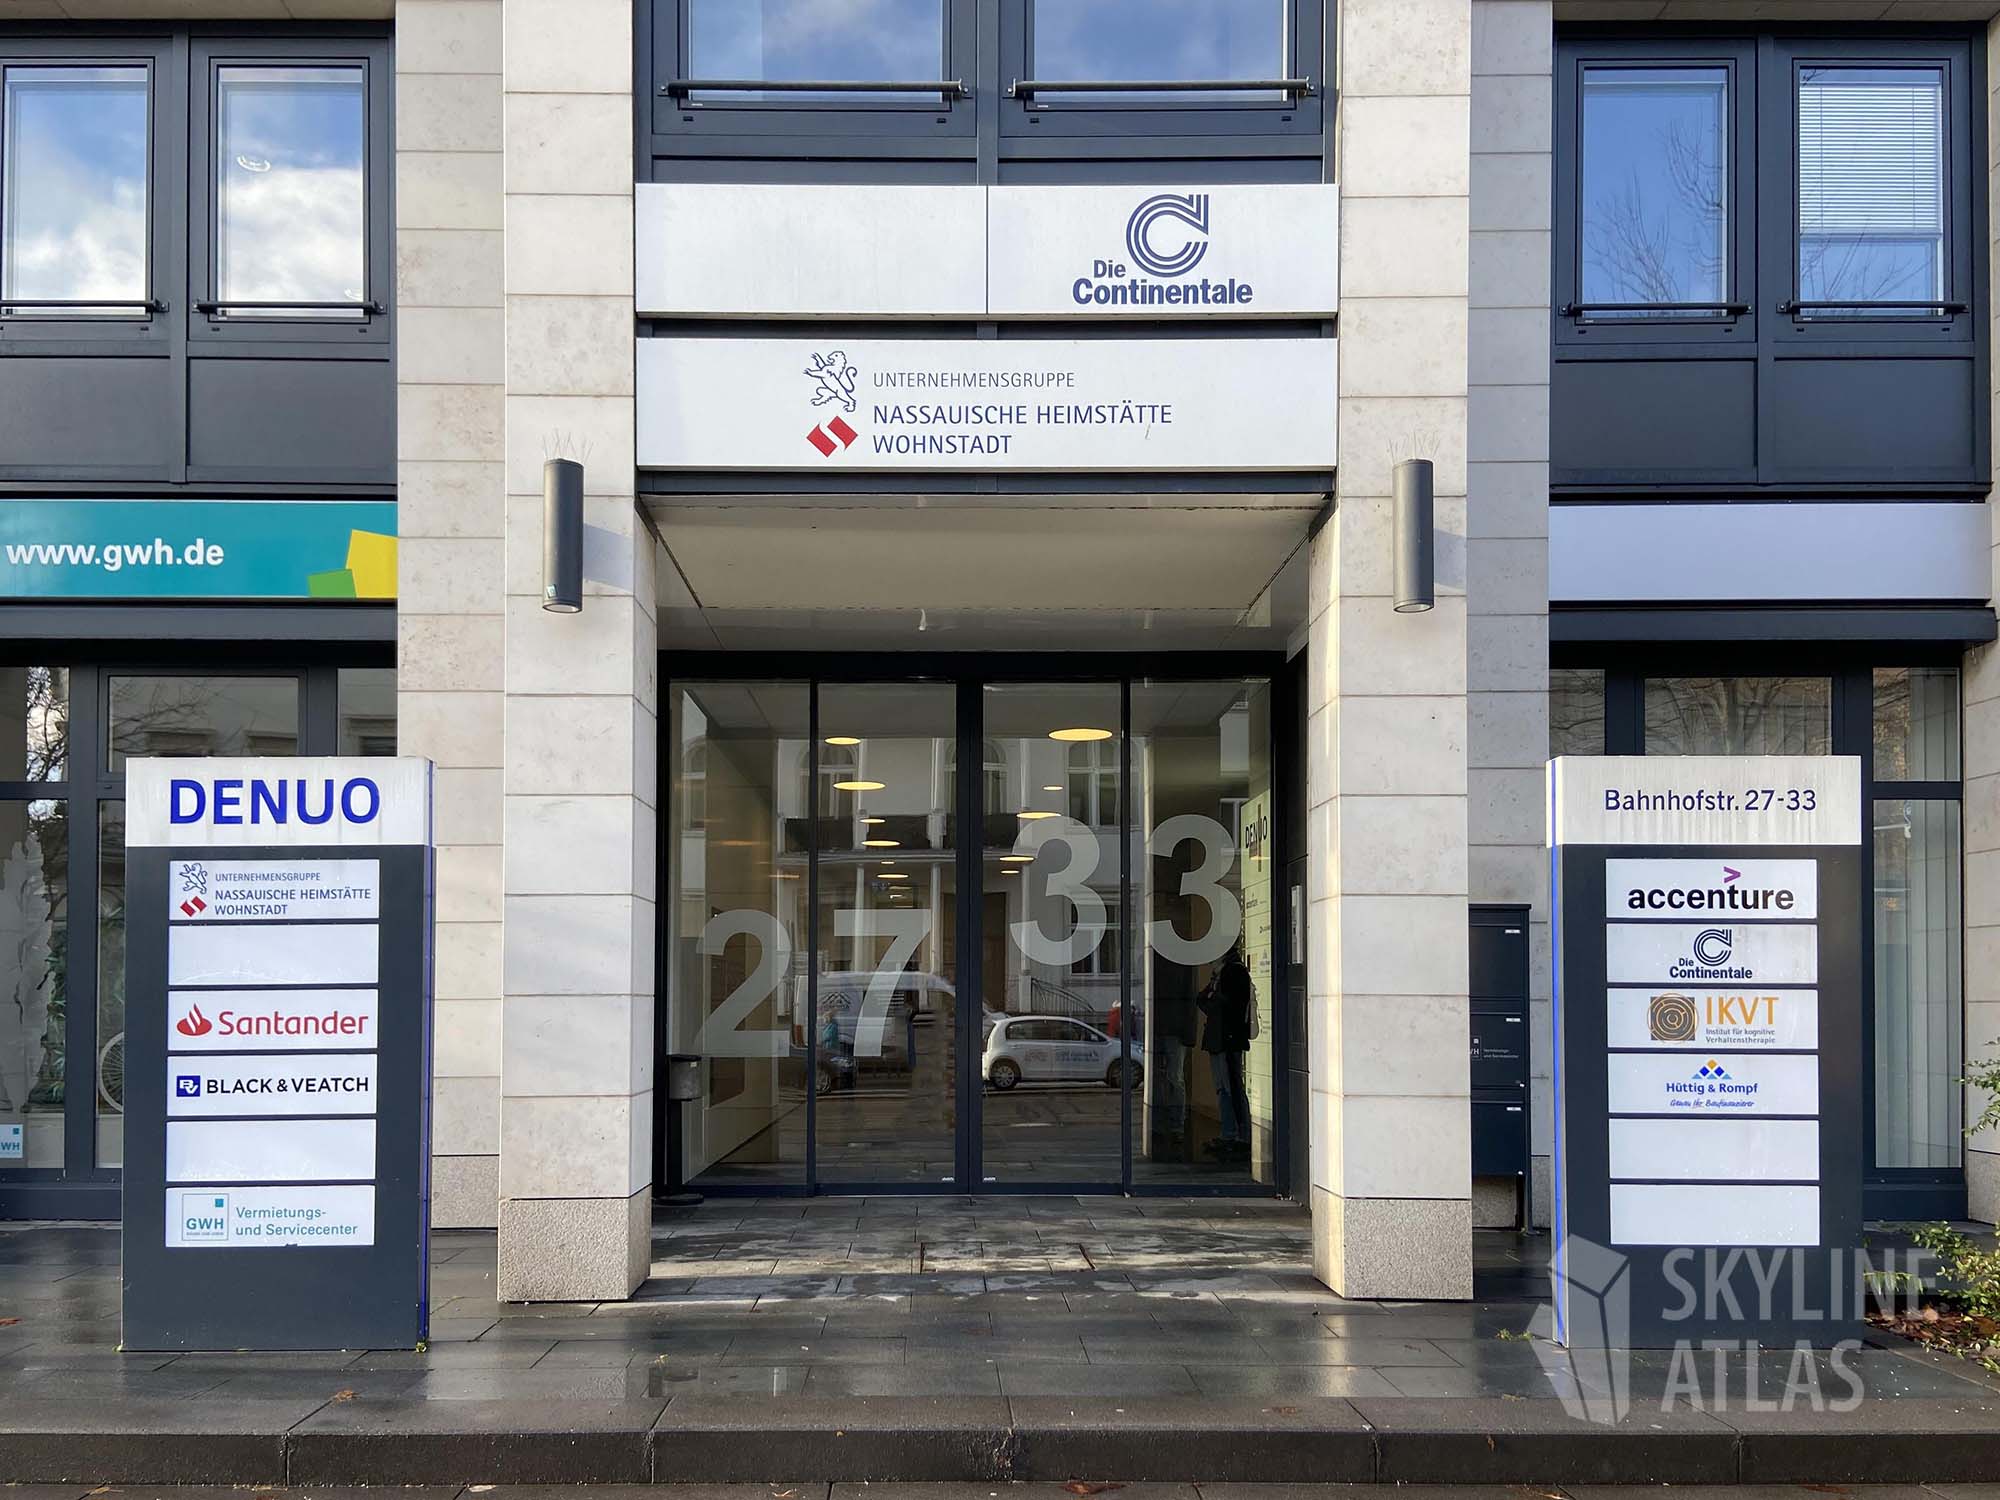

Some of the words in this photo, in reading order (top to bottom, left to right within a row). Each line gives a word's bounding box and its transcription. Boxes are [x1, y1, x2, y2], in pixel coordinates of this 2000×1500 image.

[1093, 259, 1127, 279] Die
[1072, 277, 1253, 305] Continentale
[873, 371, 1075, 388] UNTERNEHMENSGRUPPE
[873, 405, 1028, 425] NASSAUISCHE
[1036, 399, 1173, 424] HEIMSTÄTTE
[873, 434, 1012, 454] WOHNSTADT
[5, 538, 225, 571] www.gwh.de
[169, 777, 381, 825] DENUO
[1605, 789, 1740, 811] Bahnhofstr.
[1744, 789, 1817, 811] 27-33
[215, 872, 321, 882] UNTERNEHMENSGRUPPE
[215, 889, 296, 900] NASSAUISCHE
[300, 886, 371, 899] HEIMSTÄTTE
[1627, 884, 1794, 910] accenture
[215, 904, 288, 916] WOHNSTADT
[1678, 958, 1694, 967] Die
[1669, 966, 1753, 979] Continentale
[1706, 996, 1779, 1025] IKVT
[218, 1011, 369, 1036] Santander
[1706, 1036, 1775, 1044] Verhaltenstherapie
[206, 1079, 273, 1094] BLACK
[276, 1079, 288, 1092] &
[291, 1077, 369, 1092] VEATCH
[1666, 1083, 1705, 1095] Hüttig
[1707, 1084, 1716, 1093] &
[1719, 1083, 1758, 1095] Rompf
[236, 1207, 326, 1220] Vermietungs-
[186, 1217, 224, 1230] GWH
[236, 1224, 261, 1236] und
[265, 1223, 358, 1236] Servicecenter
